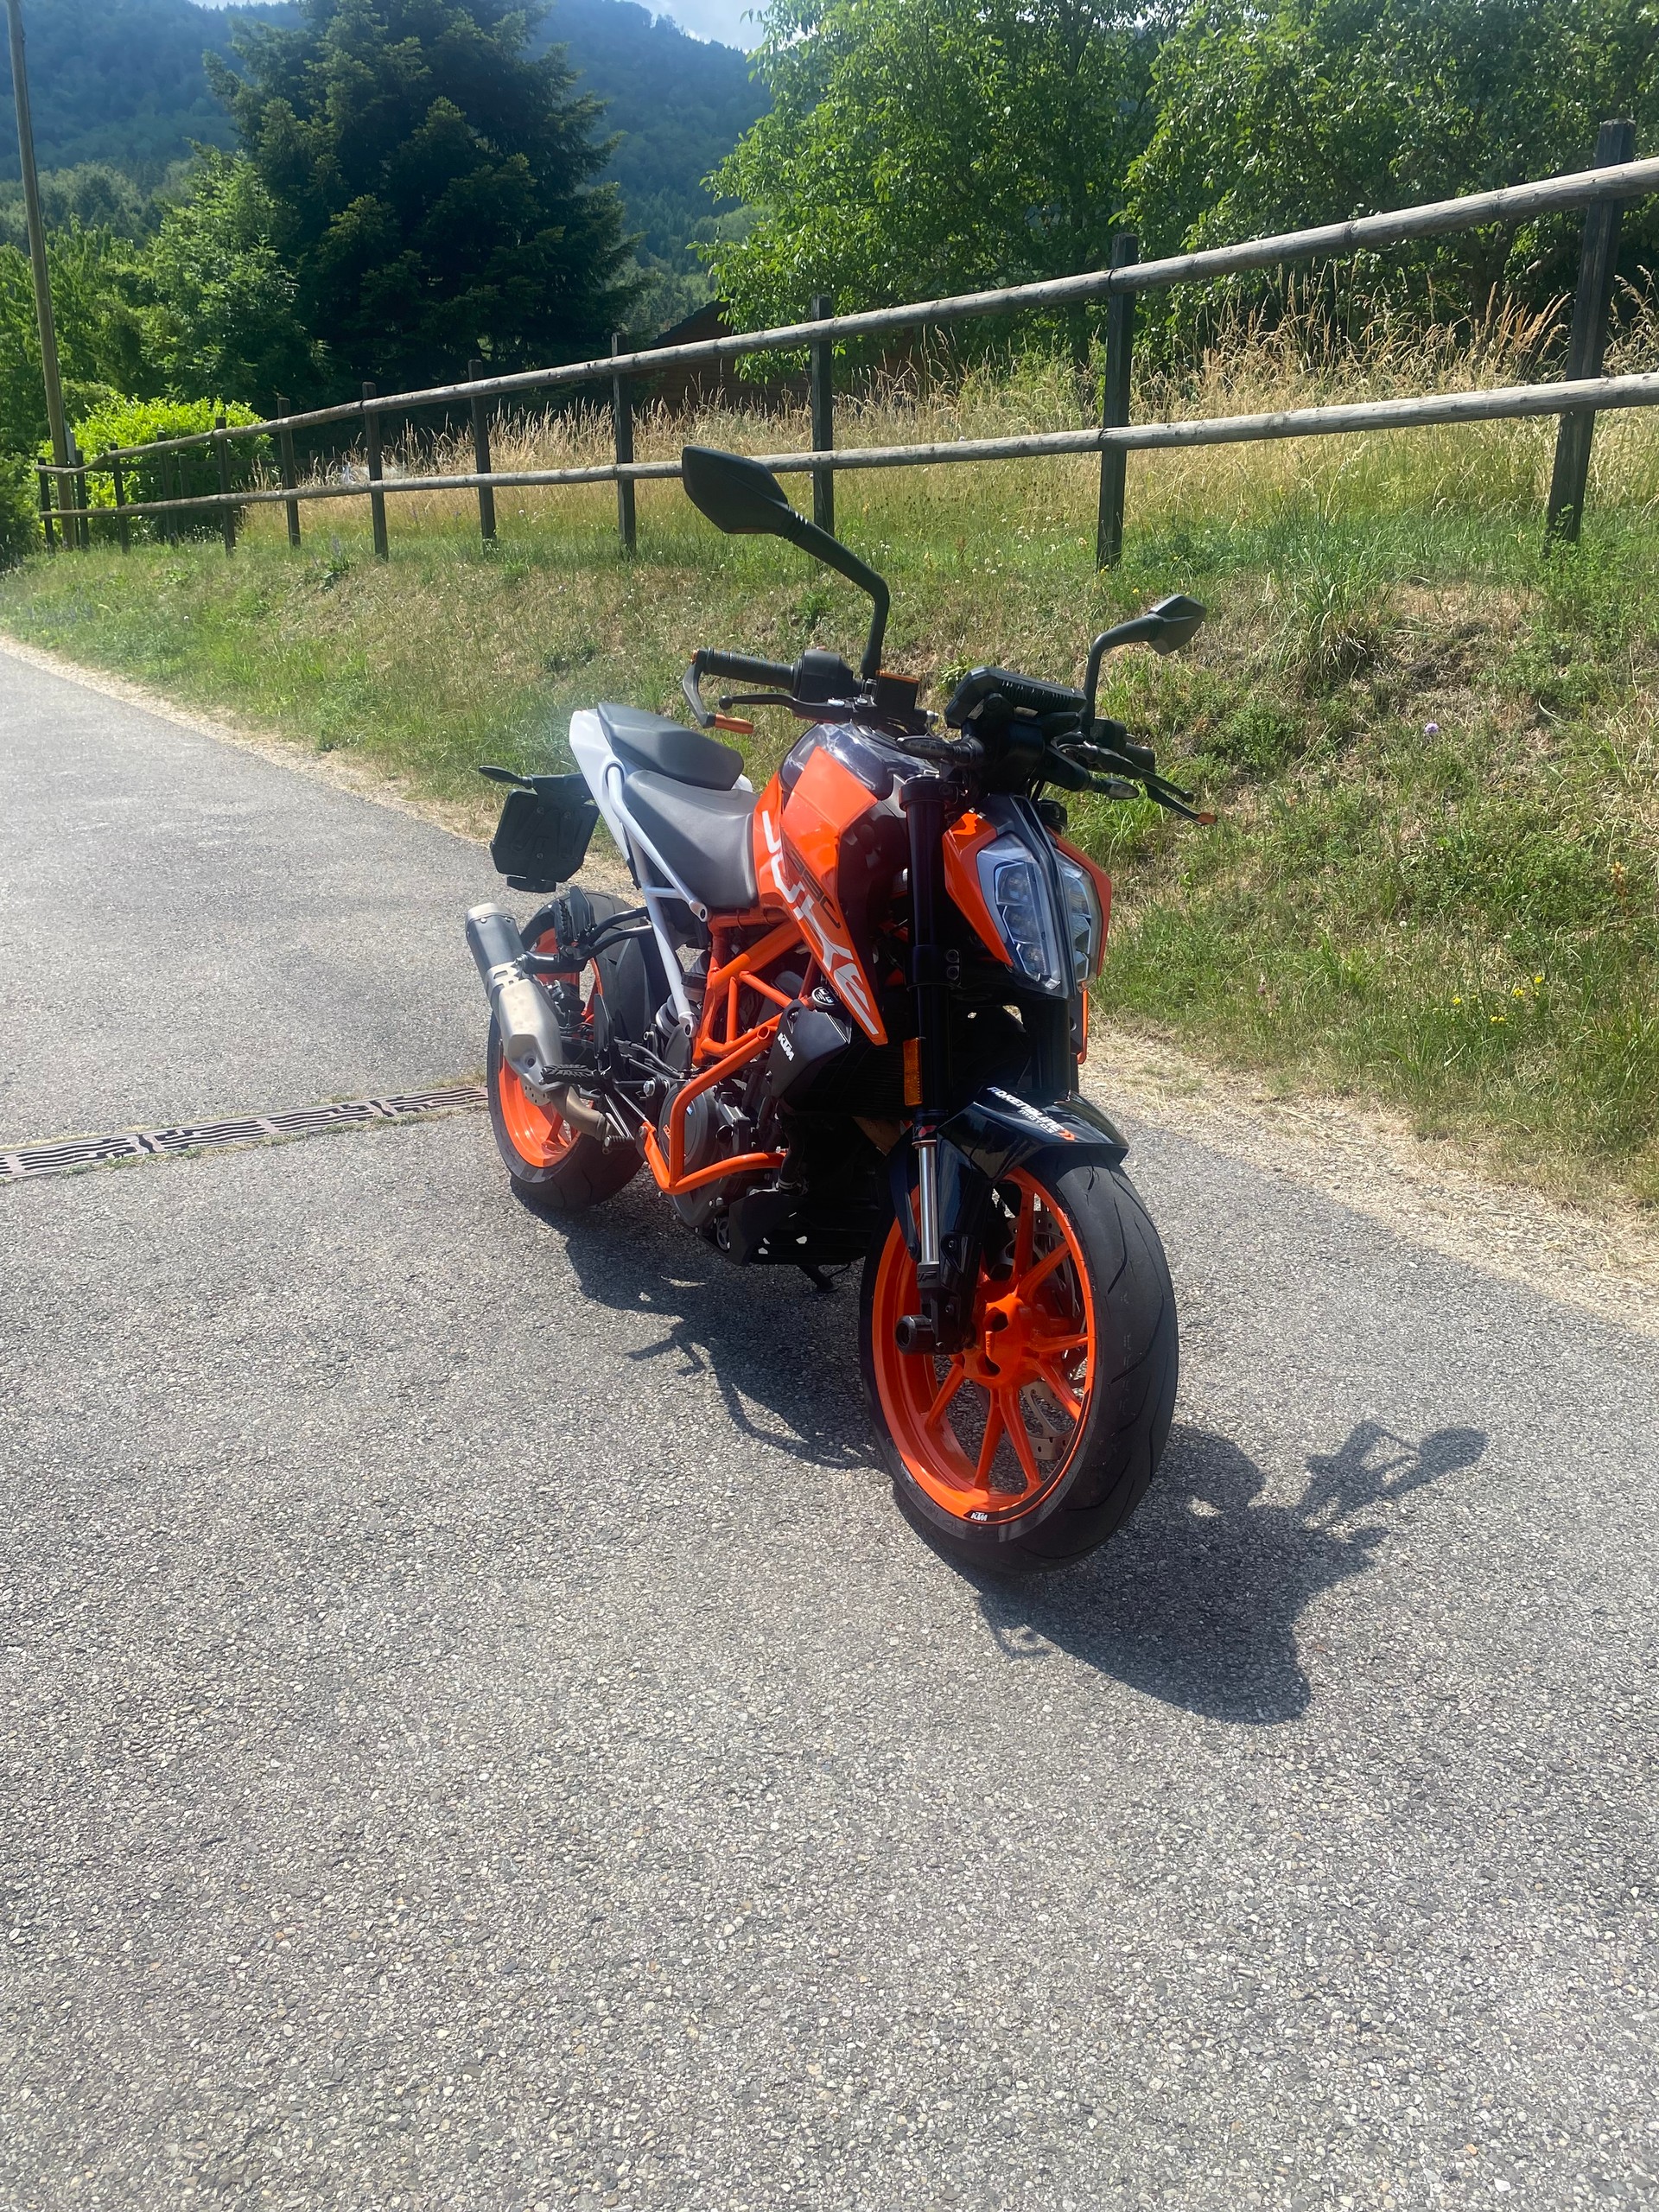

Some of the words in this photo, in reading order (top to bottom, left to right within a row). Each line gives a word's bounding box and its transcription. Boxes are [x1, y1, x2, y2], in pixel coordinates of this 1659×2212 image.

[777, 1032, 795, 1062] KTM
[1017, 1109, 1055, 1135] MOTOS
[969, 1510, 988, 1522] KTM
